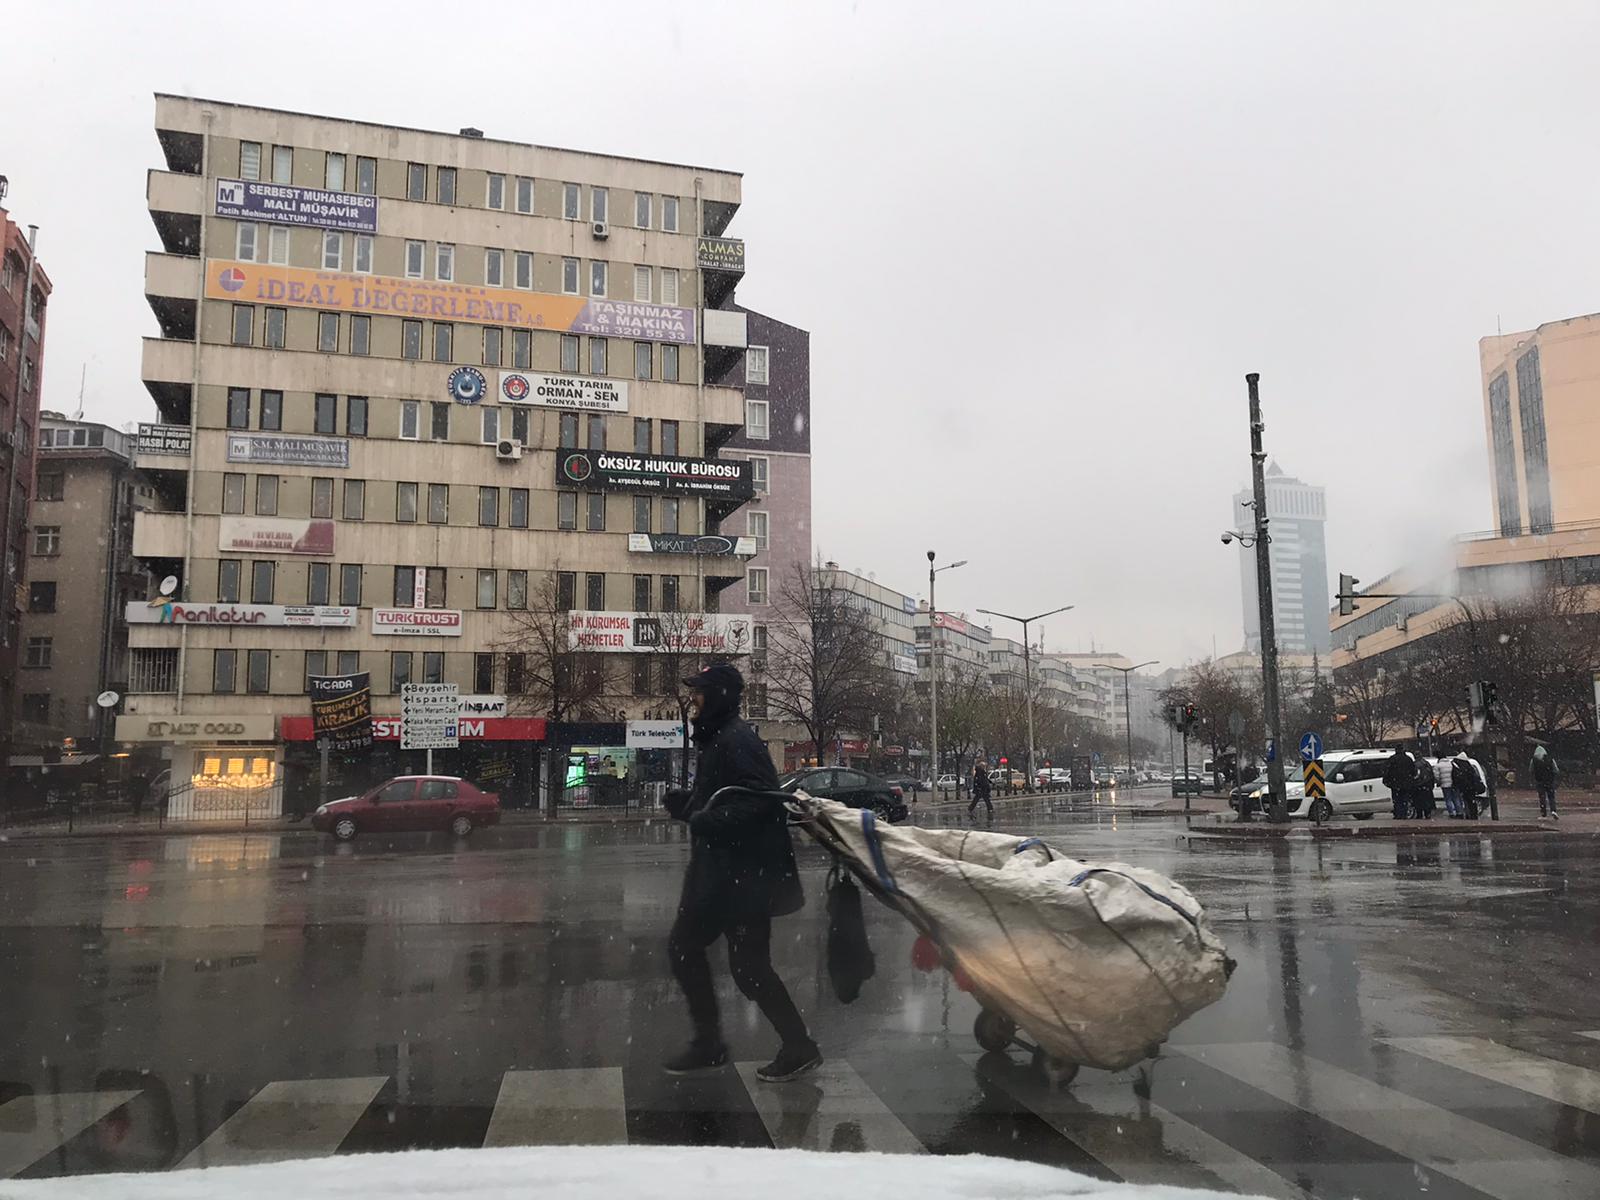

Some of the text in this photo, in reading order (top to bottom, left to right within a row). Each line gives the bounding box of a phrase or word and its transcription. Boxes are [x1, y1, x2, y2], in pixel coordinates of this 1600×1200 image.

[249, 184, 301, 200] SERBEST
[217, 206, 308, 223] Fatih Mehmet ALTUN
[264, 199, 359, 219] MALİ MÜŞAVİR
[699, 241, 744, 257] ALMAS
[592, 301, 684, 320] TAŞINMAZ
[597, 313, 609, 325] &
[582, 322, 686, 341] Tel: 320 55 33
[543, 377, 575, 388] TÜRK
[579, 380, 614, 391] TARIM
[537, 386, 583, 400] ORMAN
[594, 389, 619, 402] SEN
[546, 398, 576, 408] KONYA
[139, 437, 191, 449] HASBİ POLAT
[274, 441, 300, 451] MALİ
[598, 454, 741, 478] ÖKSÜZ HUKUK BÜROSU
[571, 615, 631, 631] HN KURUMSAL
[411, 695, 457, 705] Isparta
[464, 700, 505, 714] İNŞAAT
[425, 706, 444, 714] Meram
[424, 717, 443, 725] Meram
[203, 722, 246, 736] GOLD
[631, 728, 677, 738] Türk Telekom
